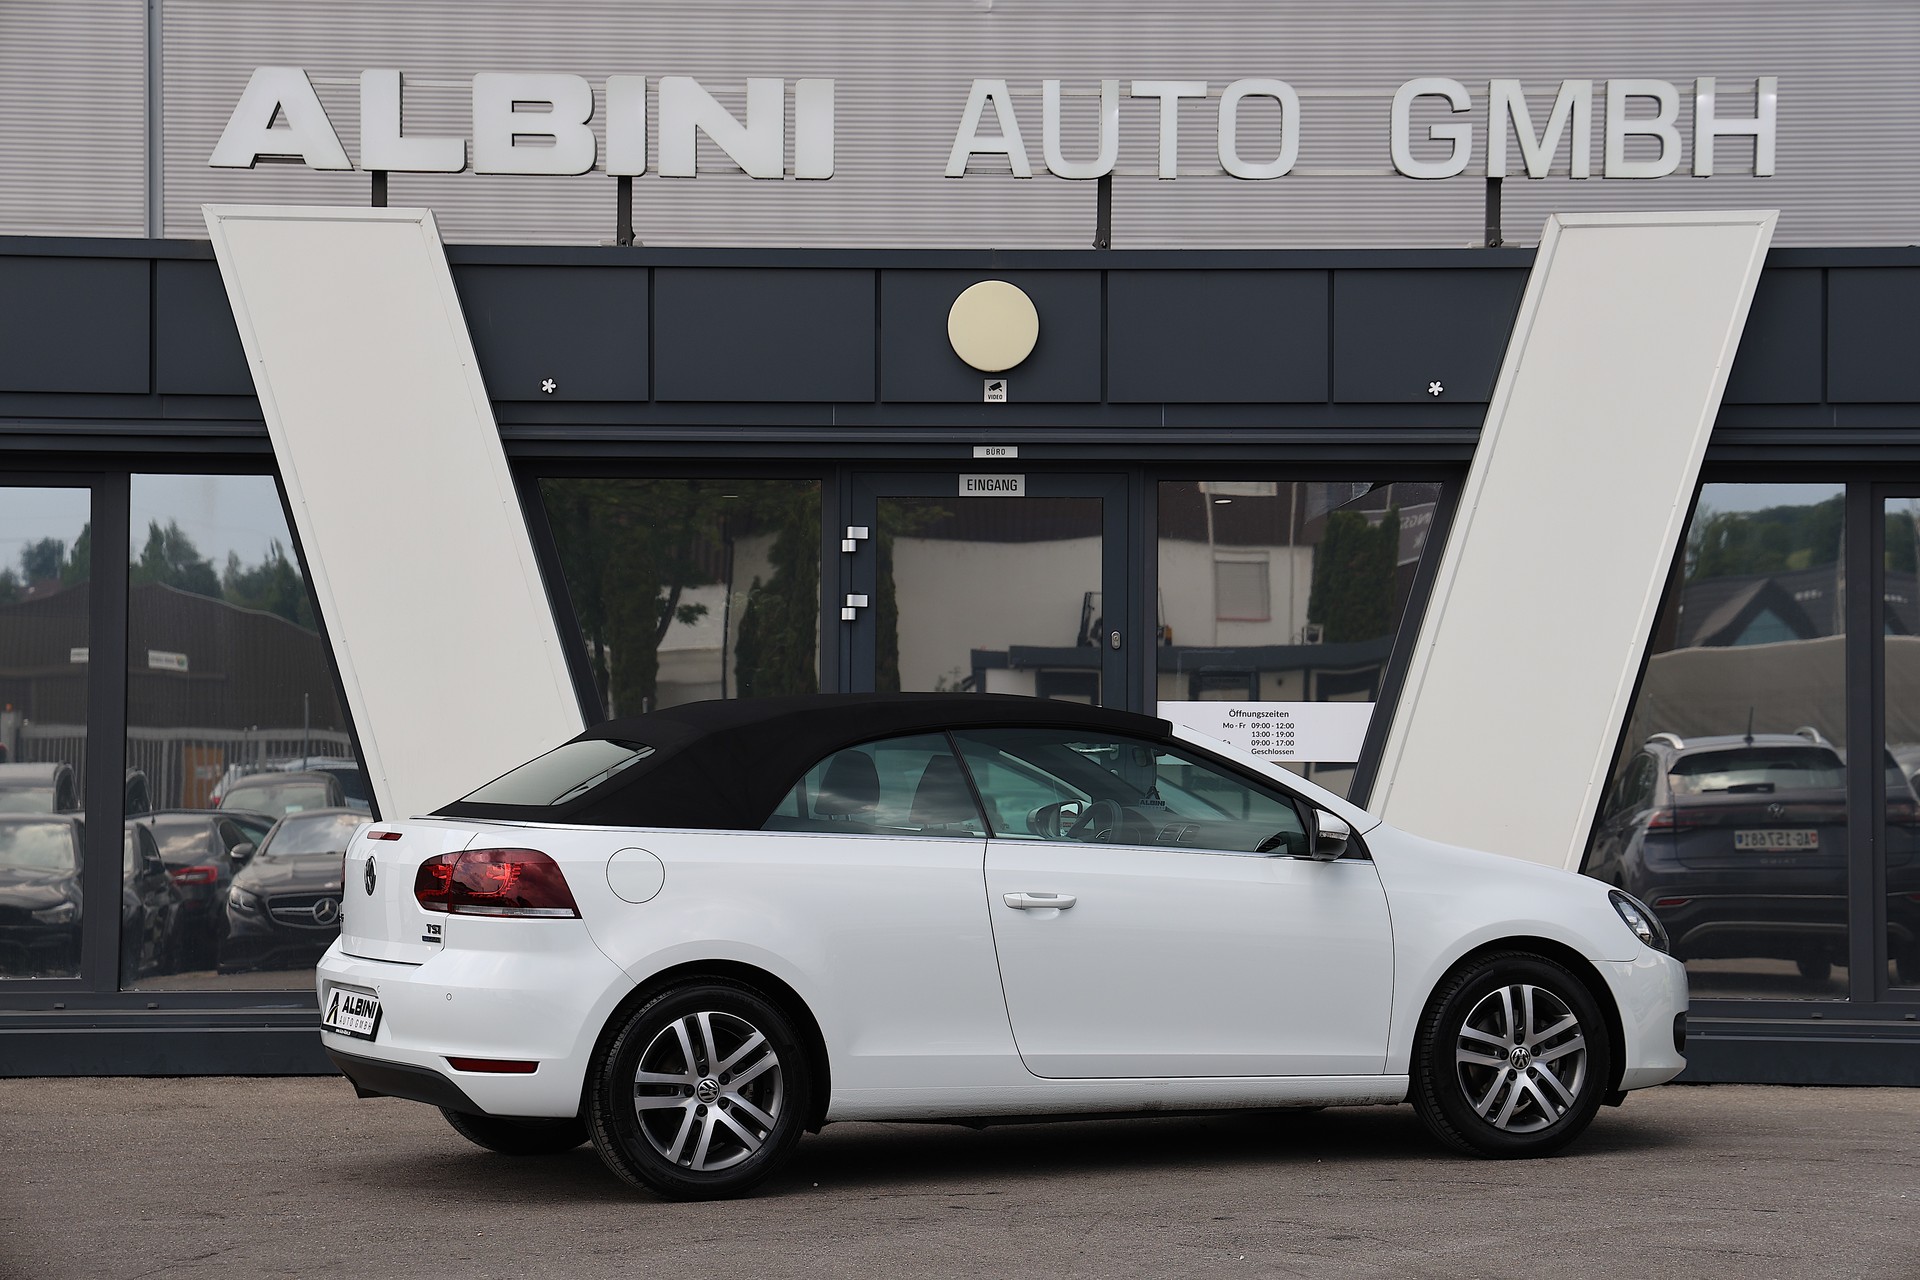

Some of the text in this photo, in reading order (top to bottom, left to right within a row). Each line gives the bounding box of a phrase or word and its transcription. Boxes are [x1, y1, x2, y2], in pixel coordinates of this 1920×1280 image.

[208, 66, 1779, 181] ALBINI AUTO GMBH
[985, 446, 1006, 456] BÜRO
[967, 479, 1018, 491] EINGANG
[1229, 709, 1289, 719] Öffnungszeiten
[426, 923, 442, 935] TSI
[341, 995, 377, 1019] ALBINI
[339, 1015, 373, 1031] AUTO GMBH
